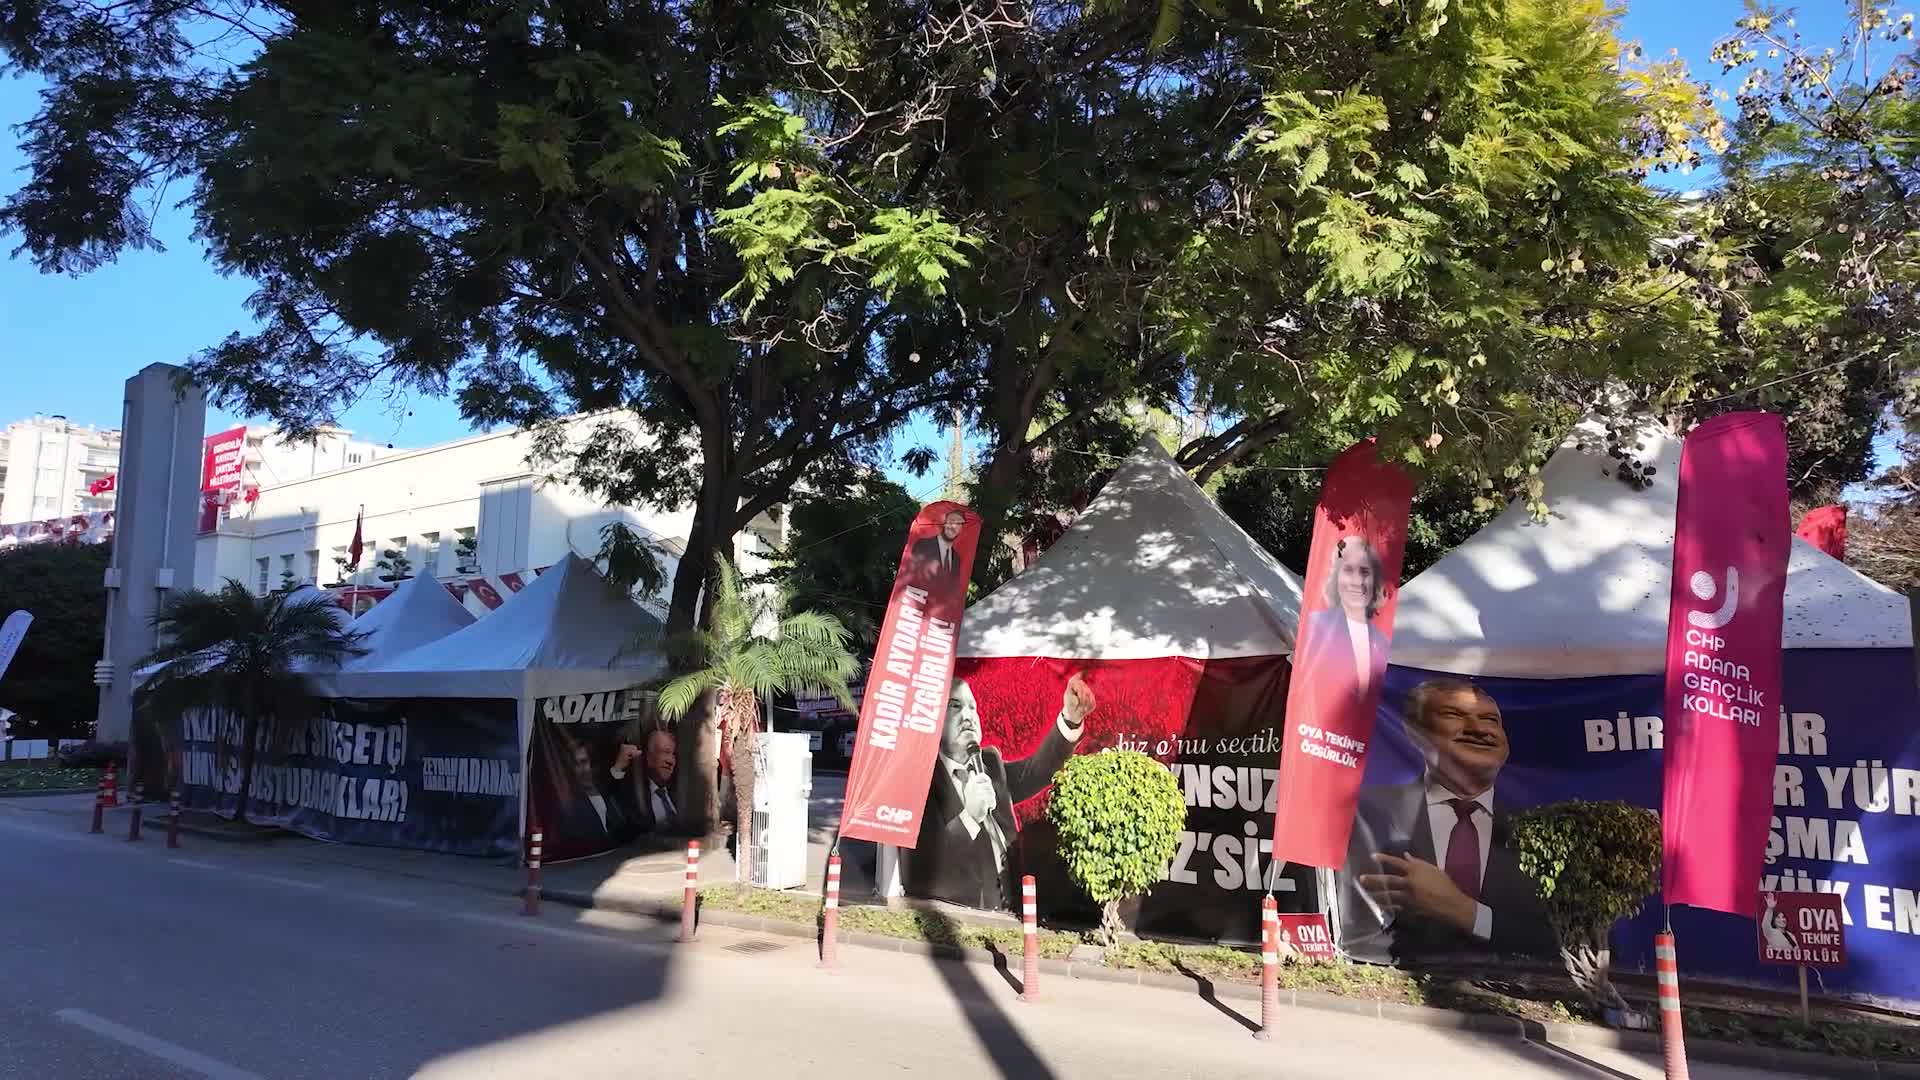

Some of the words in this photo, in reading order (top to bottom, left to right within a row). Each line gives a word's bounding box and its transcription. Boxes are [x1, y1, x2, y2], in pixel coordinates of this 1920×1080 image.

[886, 585, 928, 678] AYDAR'A
[1686, 630, 1725, 651] CHP
[903, 616, 955, 734] ÖZGÜRLÜK!
[1684, 651, 1750, 682] ADANA
[1684, 672, 1765, 707] GENÇLİK
[869, 680, 907, 750] KADİR
[1683, 694, 1761, 727] KOLLARI
[1156, 734, 1211, 755] o'nu
[1298, 724, 1323, 740] OYA
[1325, 731, 1365, 753] TEKİN'E
[1584, 712, 1664, 752] BİR
[1779, 705, 1828, 755] İR
[1301, 739, 1357, 768] ÖZGÜRLÜK
[1773, 765, 1805, 806] R
[876, 805, 913, 824] CHP
[1159, 820, 1296, 891] Z'SİZ
[1764, 816, 1869, 864] ŞMA
[1298, 925, 1327, 942] OYA
[1800, 908, 1839, 931] OYA
[1801, 932, 1840, 945] TEKİN'E
